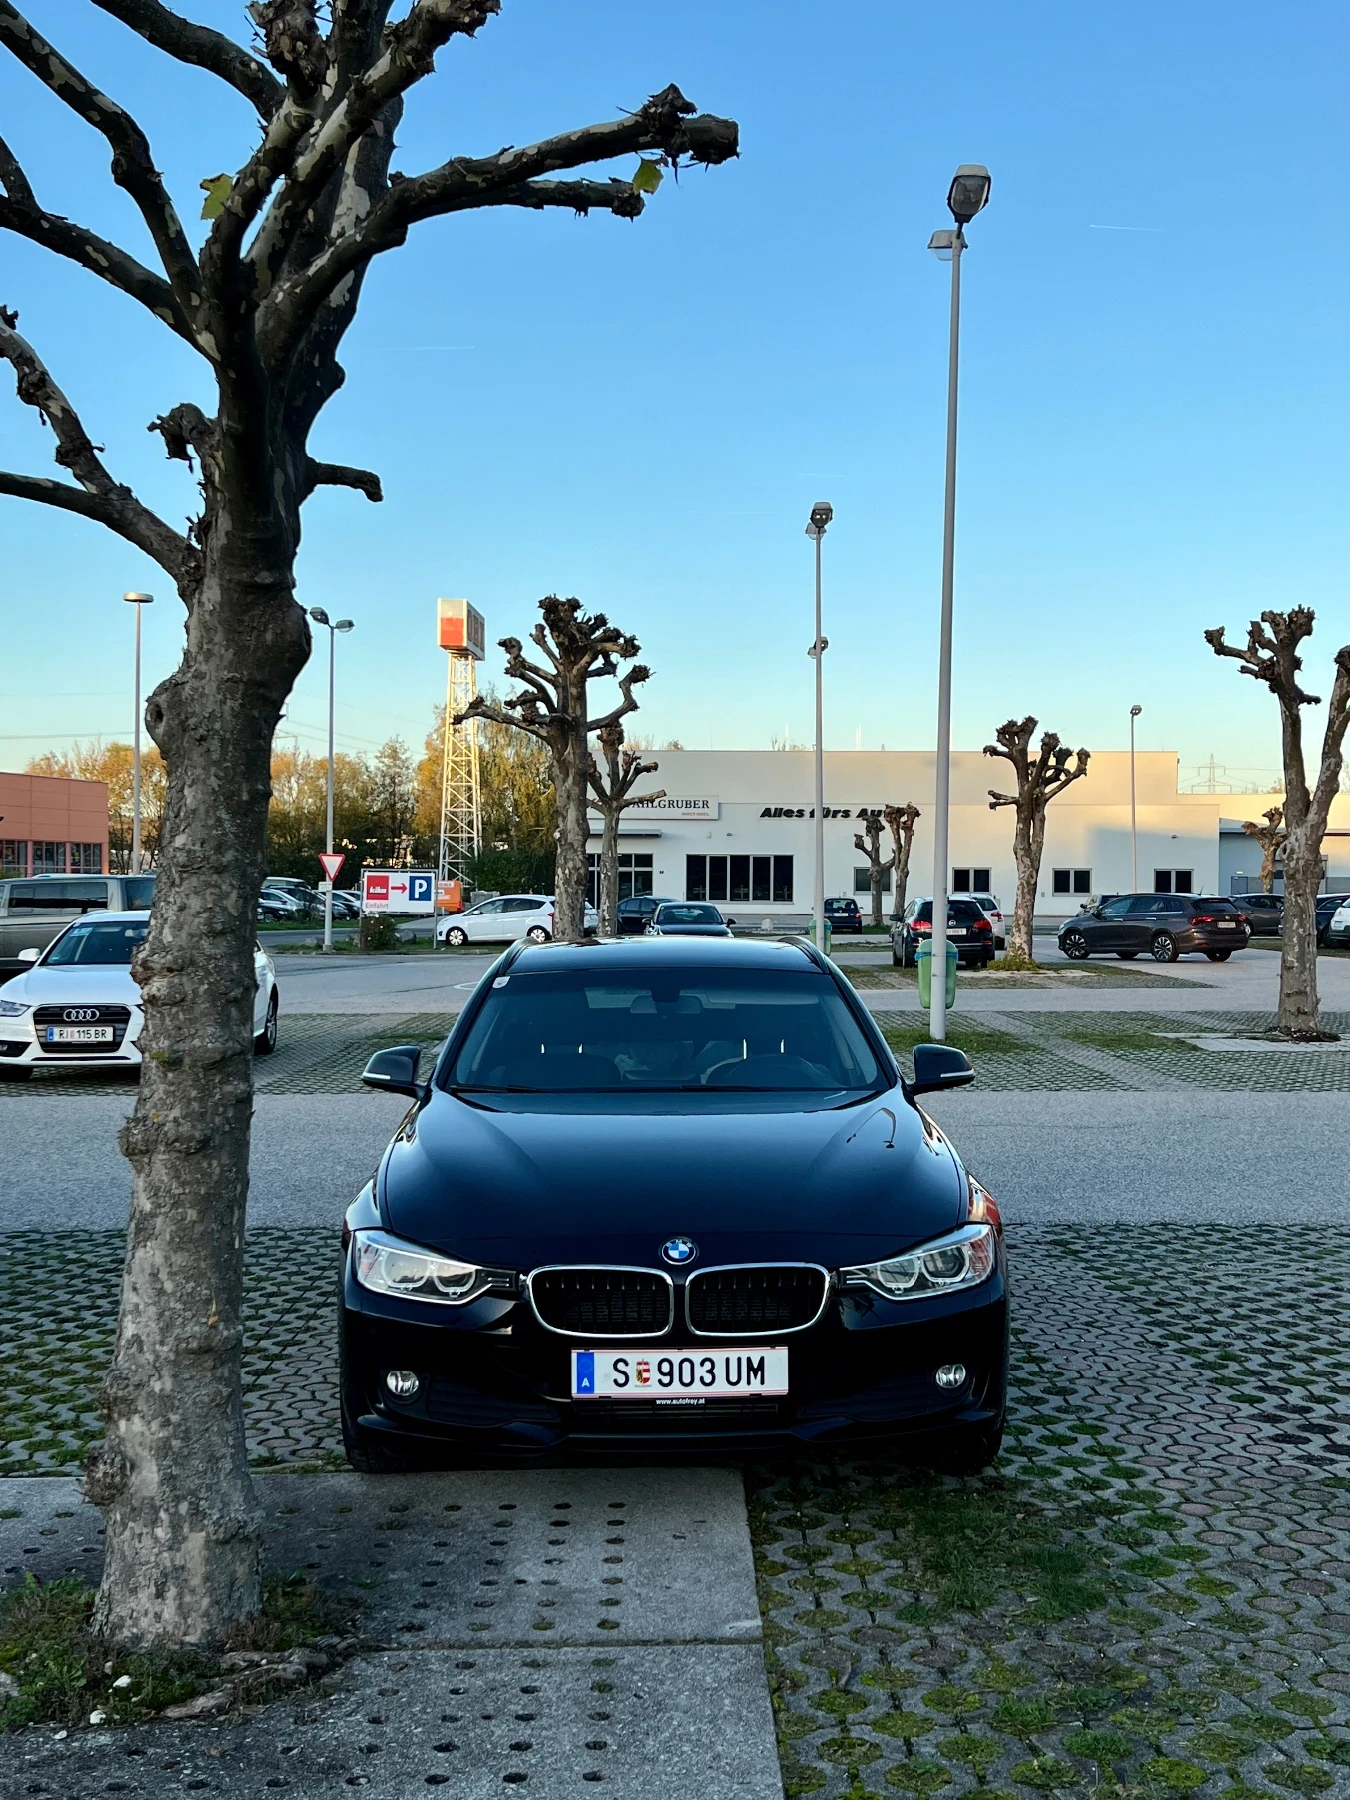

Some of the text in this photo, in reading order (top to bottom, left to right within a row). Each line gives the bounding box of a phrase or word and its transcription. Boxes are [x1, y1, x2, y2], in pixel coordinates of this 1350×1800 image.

[631, 799, 710, 809] AHLGRUBER
[760, 807, 805, 818] Alles
[414, 879, 428, 899] P
[365, 902, 389, 910] Einfahrt
[59, 1029, 107, 1039] RI 115 BR
[612, 1356, 765, 1388] S 903 UM
[581, 1377, 590, 1388] A
[655, 1398, 706, 1406] www.autofrey.at
